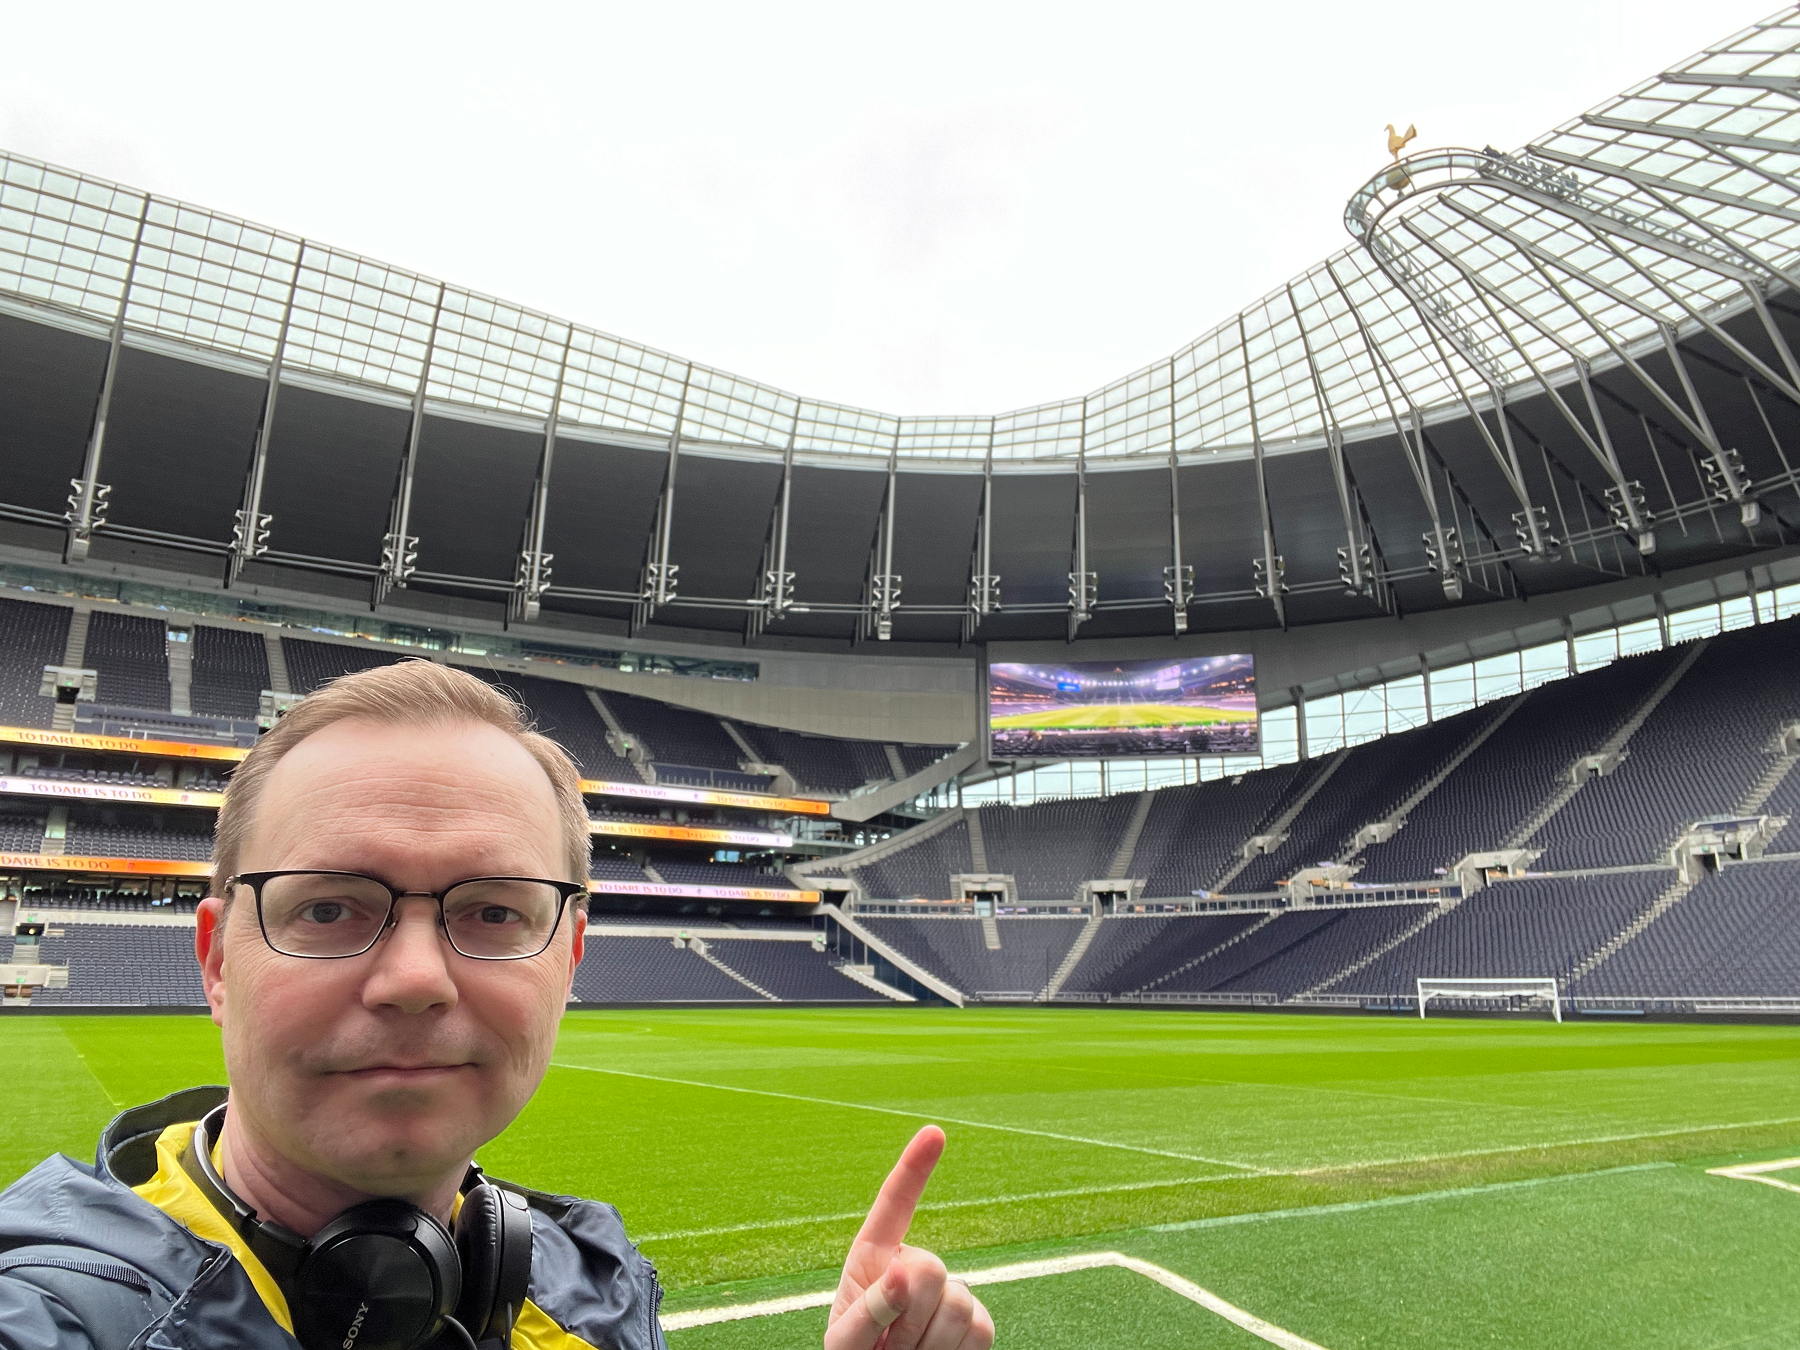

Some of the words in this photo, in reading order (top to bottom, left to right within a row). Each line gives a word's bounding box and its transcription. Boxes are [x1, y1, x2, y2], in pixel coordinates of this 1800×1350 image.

[17, 732, 36, 741] TO
[40, 734, 76, 745] DARE
[82, 738, 94, 747] IS
[98, 739, 116, 749] TO
[119, 741, 139, 750] DO
[30, 783, 48, 792] TO
[52, 785, 91, 796] DARE
[95, 788, 107, 797] IS
[110, 790, 129, 799] TO
[132, 791, 152, 800] DO
[587, 783, 600, 791] TO
[601, 785, 625, 793] DARE
[629, 787, 638, 795] IS
[591, 824, 616, 832] DARE
[1, 855, 44, 867] DARE
[46, 858, 61, 868] IS
[63, 859, 85, 869] TO
[88, 861, 110, 870] DO
[599, 883, 613, 891] TO
[614, 884, 640, 893] DARE
[728, 890, 751, 898] DARE
[342, 1301, 369, 1350] SONY
